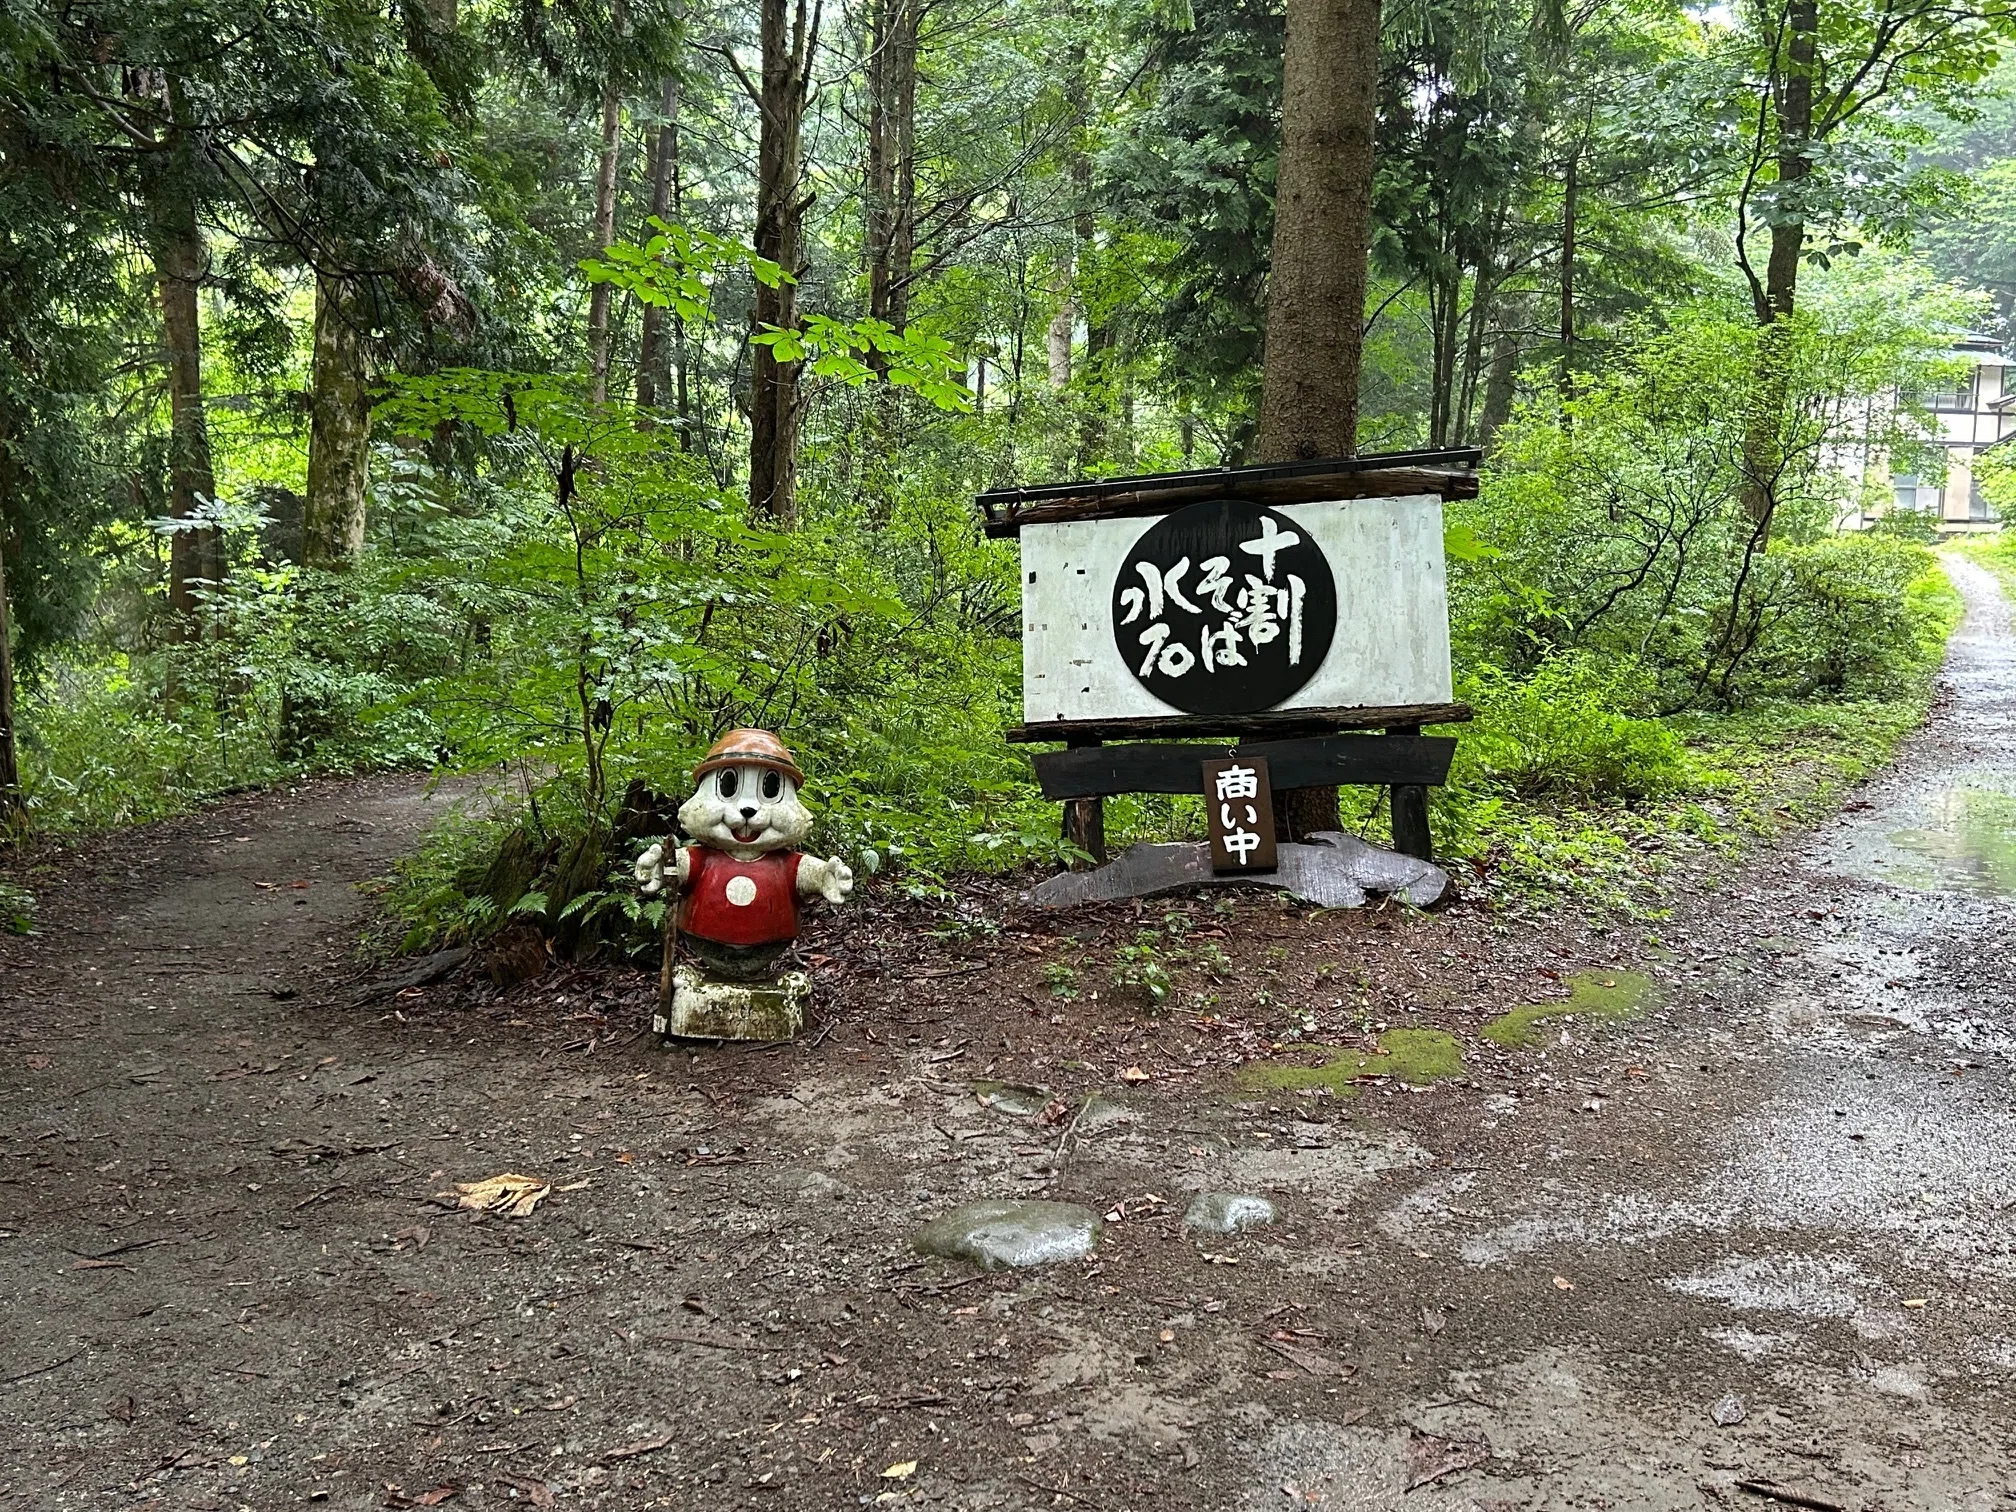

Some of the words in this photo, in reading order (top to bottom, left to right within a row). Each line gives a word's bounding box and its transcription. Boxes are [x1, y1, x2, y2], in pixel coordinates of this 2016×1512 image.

[1196, 556, 1248, 673] そば
[1235, 516, 1306, 666] 十割
[1216, 765, 1260, 865] 商い中
